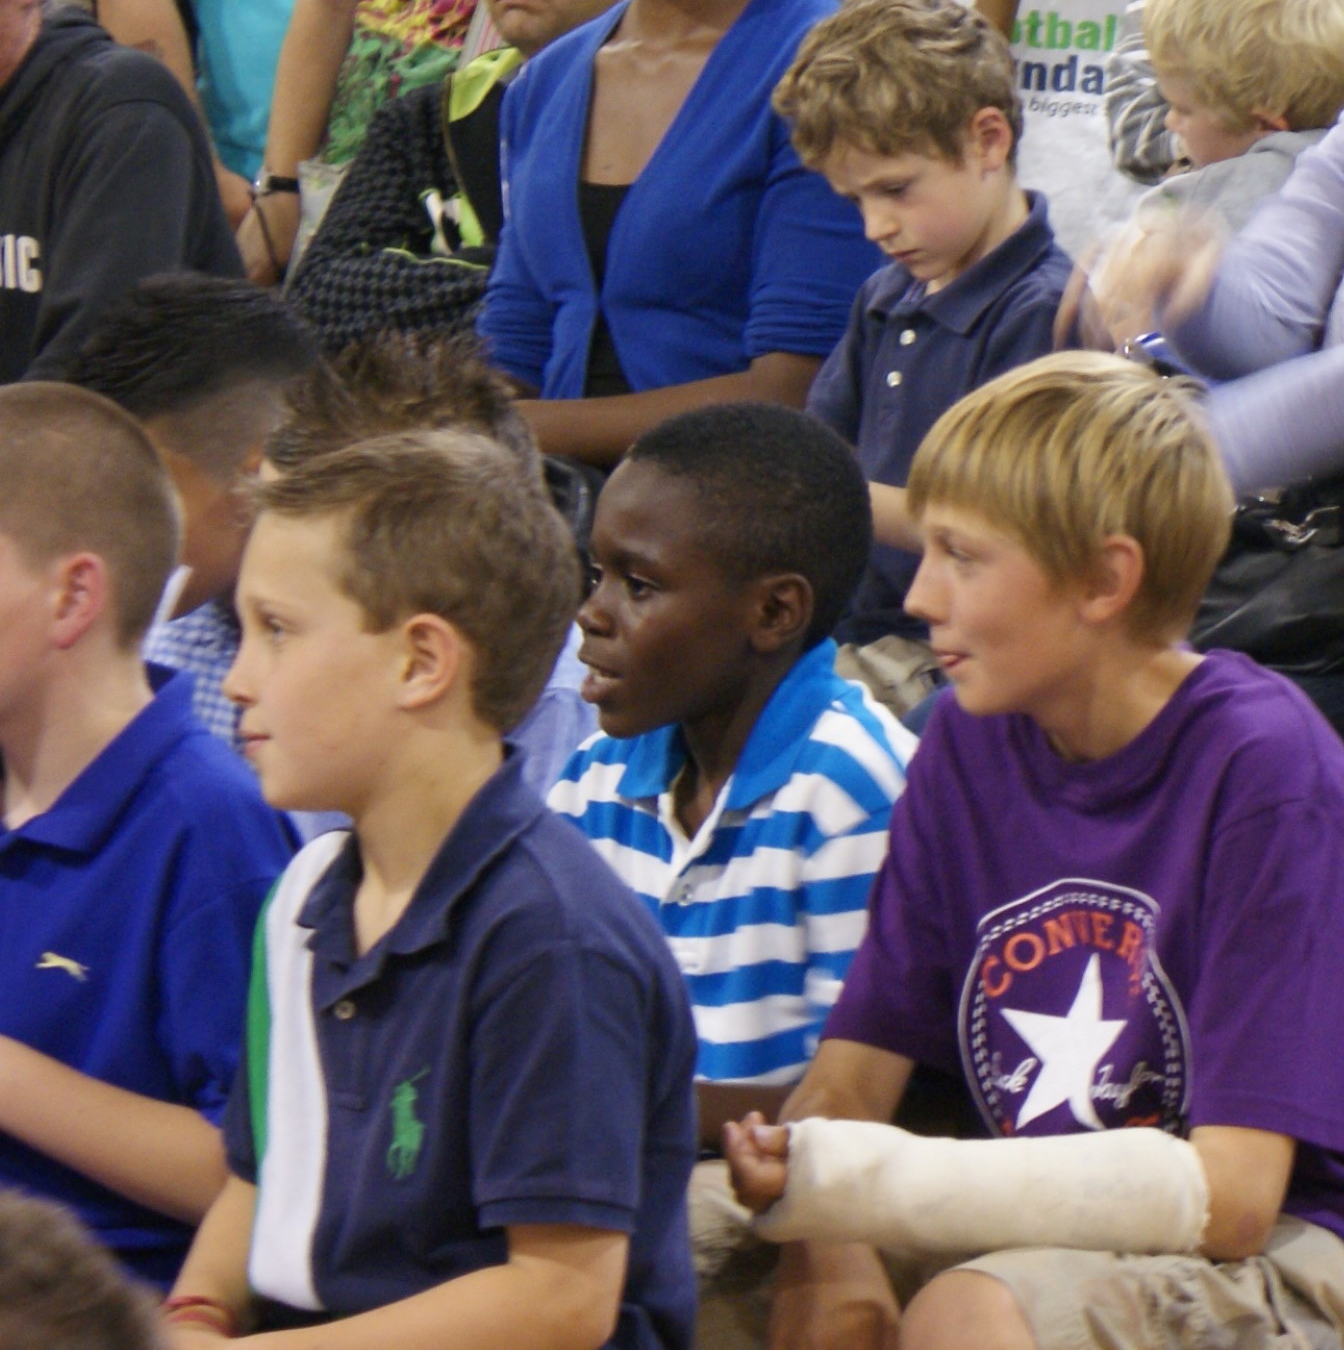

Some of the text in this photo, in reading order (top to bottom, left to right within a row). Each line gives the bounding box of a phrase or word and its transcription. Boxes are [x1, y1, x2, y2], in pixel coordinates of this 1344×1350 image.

[1010, 10, 1118, 52] tbal
[1013, 53, 1104, 96] nda
[0, 233, 43, 294] IC
